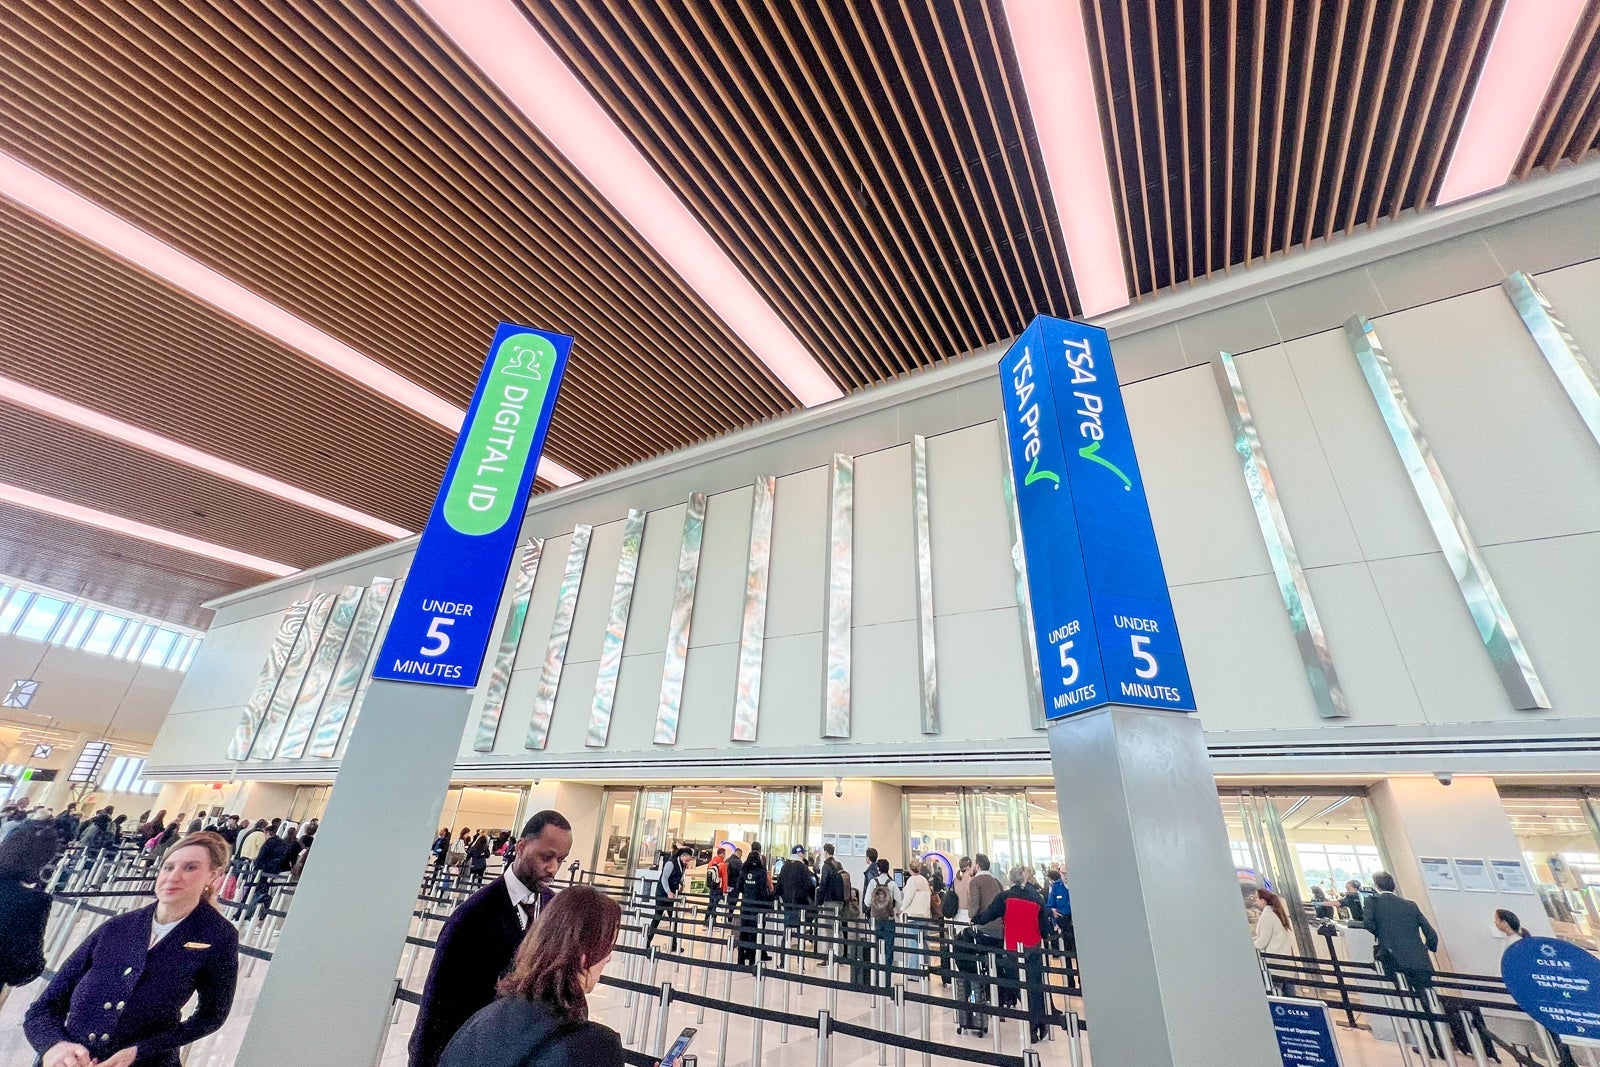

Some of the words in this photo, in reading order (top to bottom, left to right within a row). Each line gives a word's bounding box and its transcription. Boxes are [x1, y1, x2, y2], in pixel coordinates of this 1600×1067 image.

[1063, 338, 1097, 384] TSA
[1012, 346, 1035, 412] TSA
[1073, 391, 1104, 441] Pre
[477, 384, 528, 476] DIGITAL
[1020, 402, 1041, 462] Pre
[468, 484, 498, 511] ID
[422, 599, 473, 616] UNDER
[420, 616, 455, 657] 5
[1048, 620, 1080, 644] UNDER
[1114, 614, 1159, 633] UNDER
[393, 659, 462, 678] MINUTES
[1059, 640, 1079, 686] 5
[1130, 635, 1158, 679] 5
[1053, 684, 1096, 709] MINUTES
[1120, 681, 1180, 701] MINUTES
[1536, 959, 1571, 968] CLEAR
[1539, 1006, 1565, 1014] CLEAR
